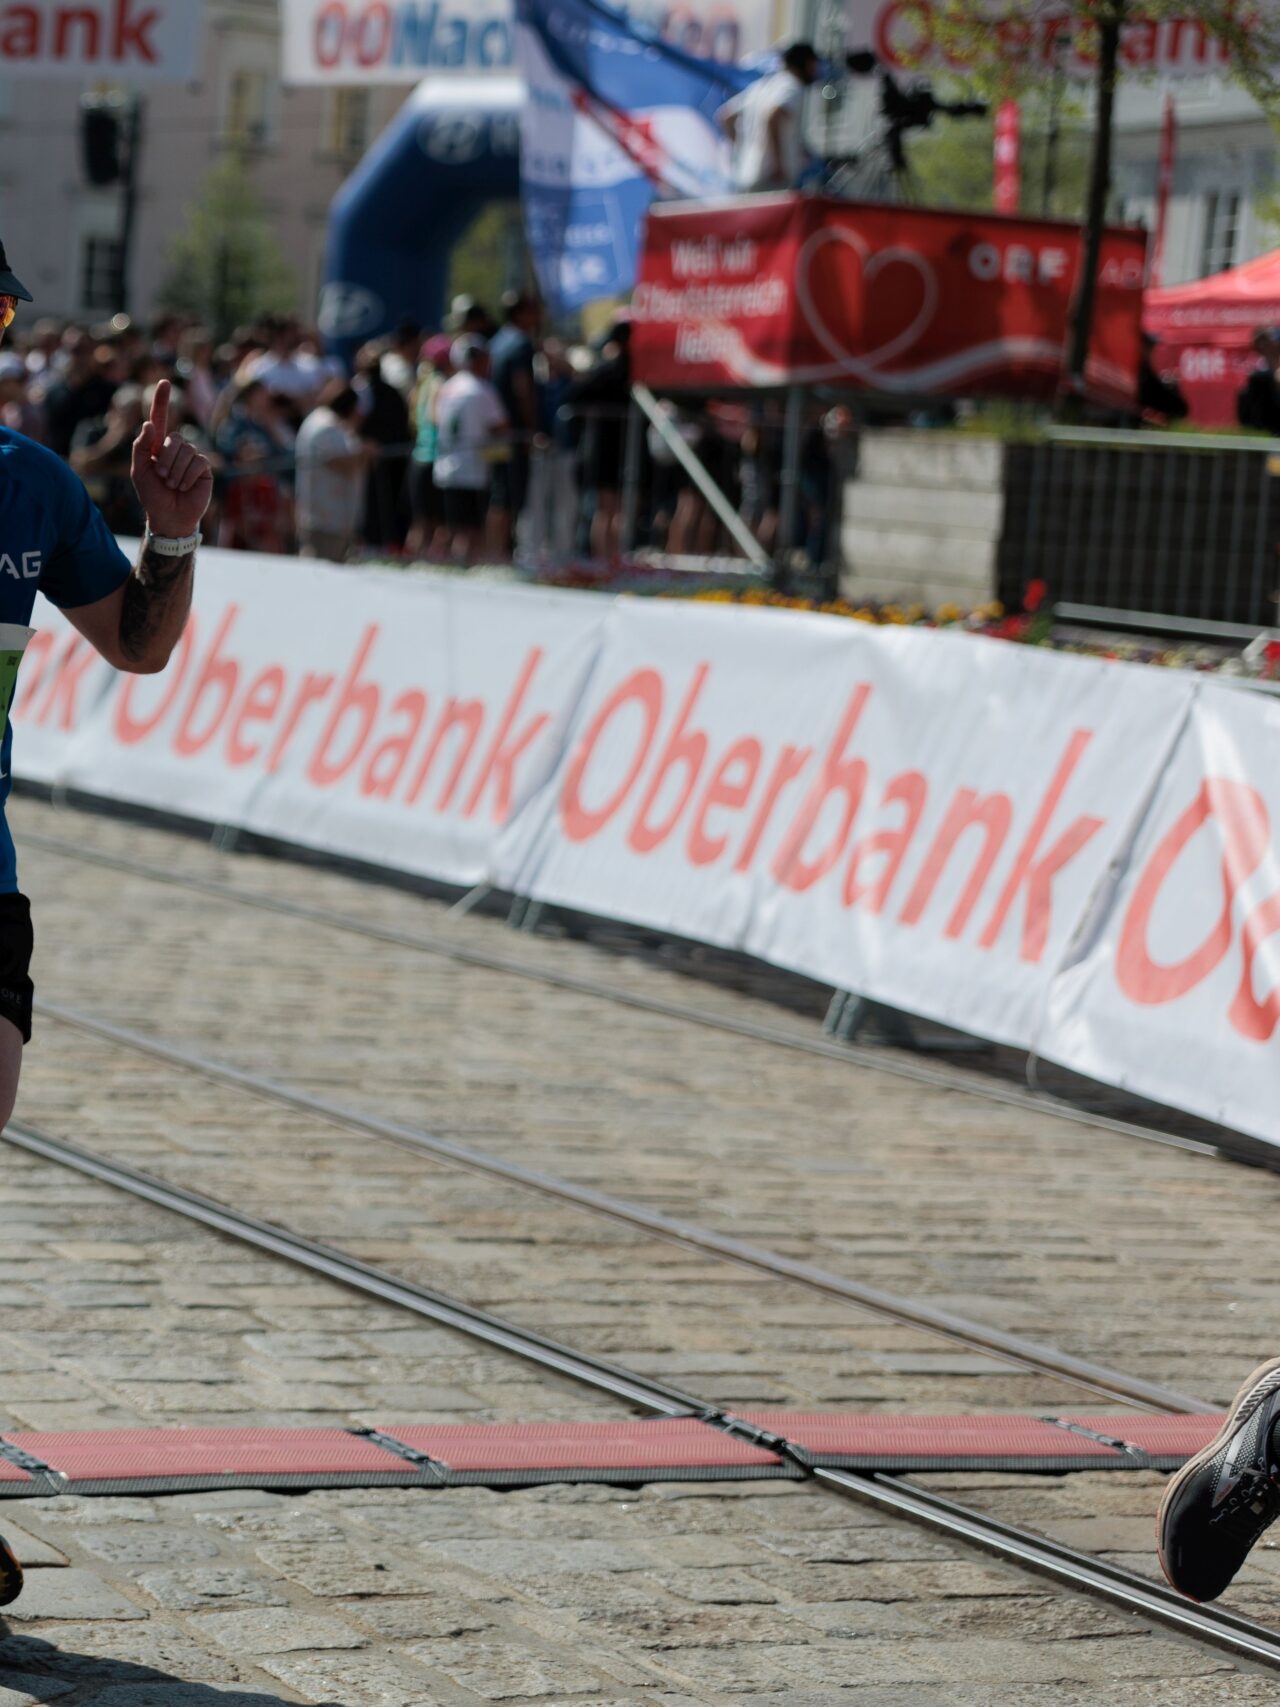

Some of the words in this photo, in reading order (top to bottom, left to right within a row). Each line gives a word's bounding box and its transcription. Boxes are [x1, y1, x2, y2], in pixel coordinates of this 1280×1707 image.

[967, 241, 1070, 287] ORF
[113, 603, 558, 824] Oberbank
[561, 662, 1106, 964] Oberbank
